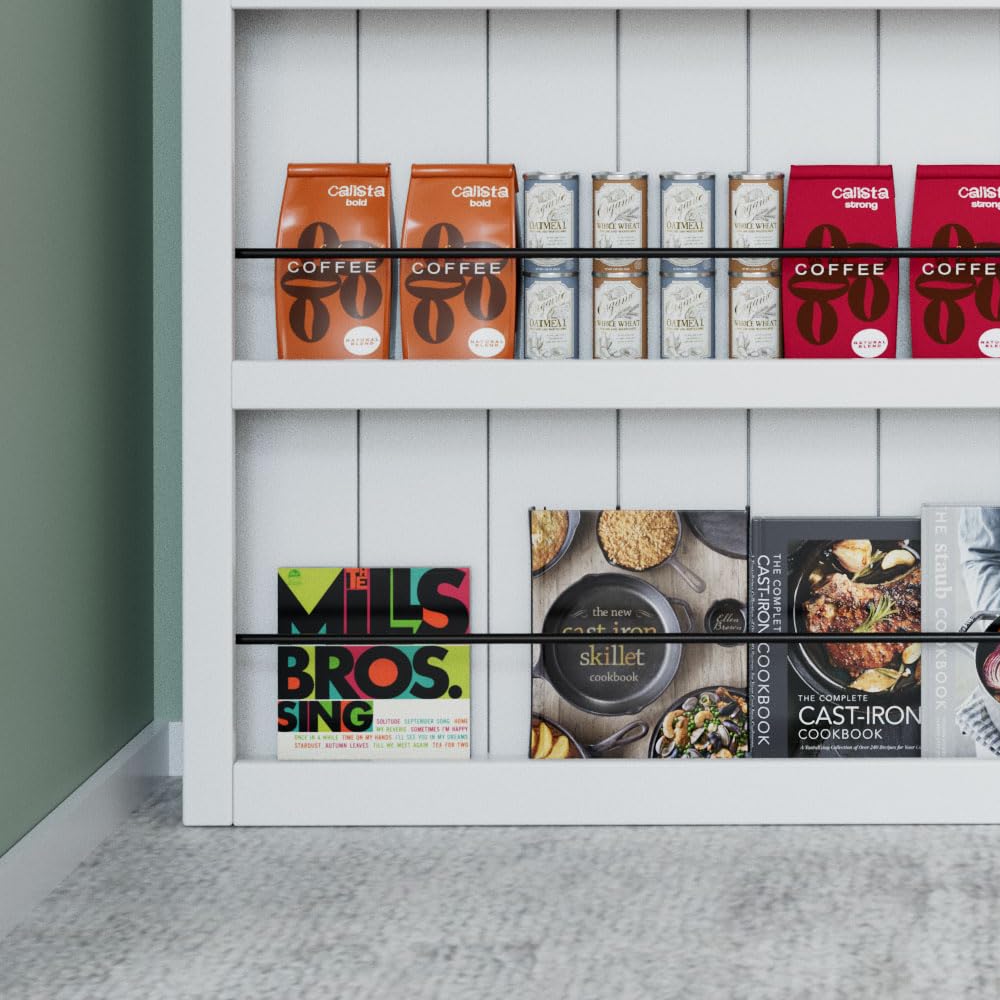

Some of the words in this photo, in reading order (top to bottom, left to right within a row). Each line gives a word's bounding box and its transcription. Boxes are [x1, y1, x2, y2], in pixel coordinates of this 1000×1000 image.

[345, 198, 367, 206] bold
[469, 199, 491, 207] bold
[844, 201, 878, 210] strong
[287, 261, 377, 273] COFFEE
[412, 262, 501, 274] COFFEE
[795, 263, 884, 276] COFFEE
[773, 553, 781, 574] THE
[935, 543, 952, 598] staub
[592, 606, 609, 617] the
[611, 609, 632, 617] new
[773, 579, 781, 632] COMPLET
[716, 614, 739, 623] Ellen
[713, 620, 742, 632] Brown
[579, 644, 646, 666] skillet
[935, 607, 947, 709] COKBOOK
[278, 646, 462, 699] BROS.
[589, 672, 638, 682] cookbook
[757, 643, 770, 746] COOKBOOK
[278, 701, 373, 732] SING
[799, 705, 921, 725] CAST-IRON
[798, 729, 882, 740] COOKBOOK
